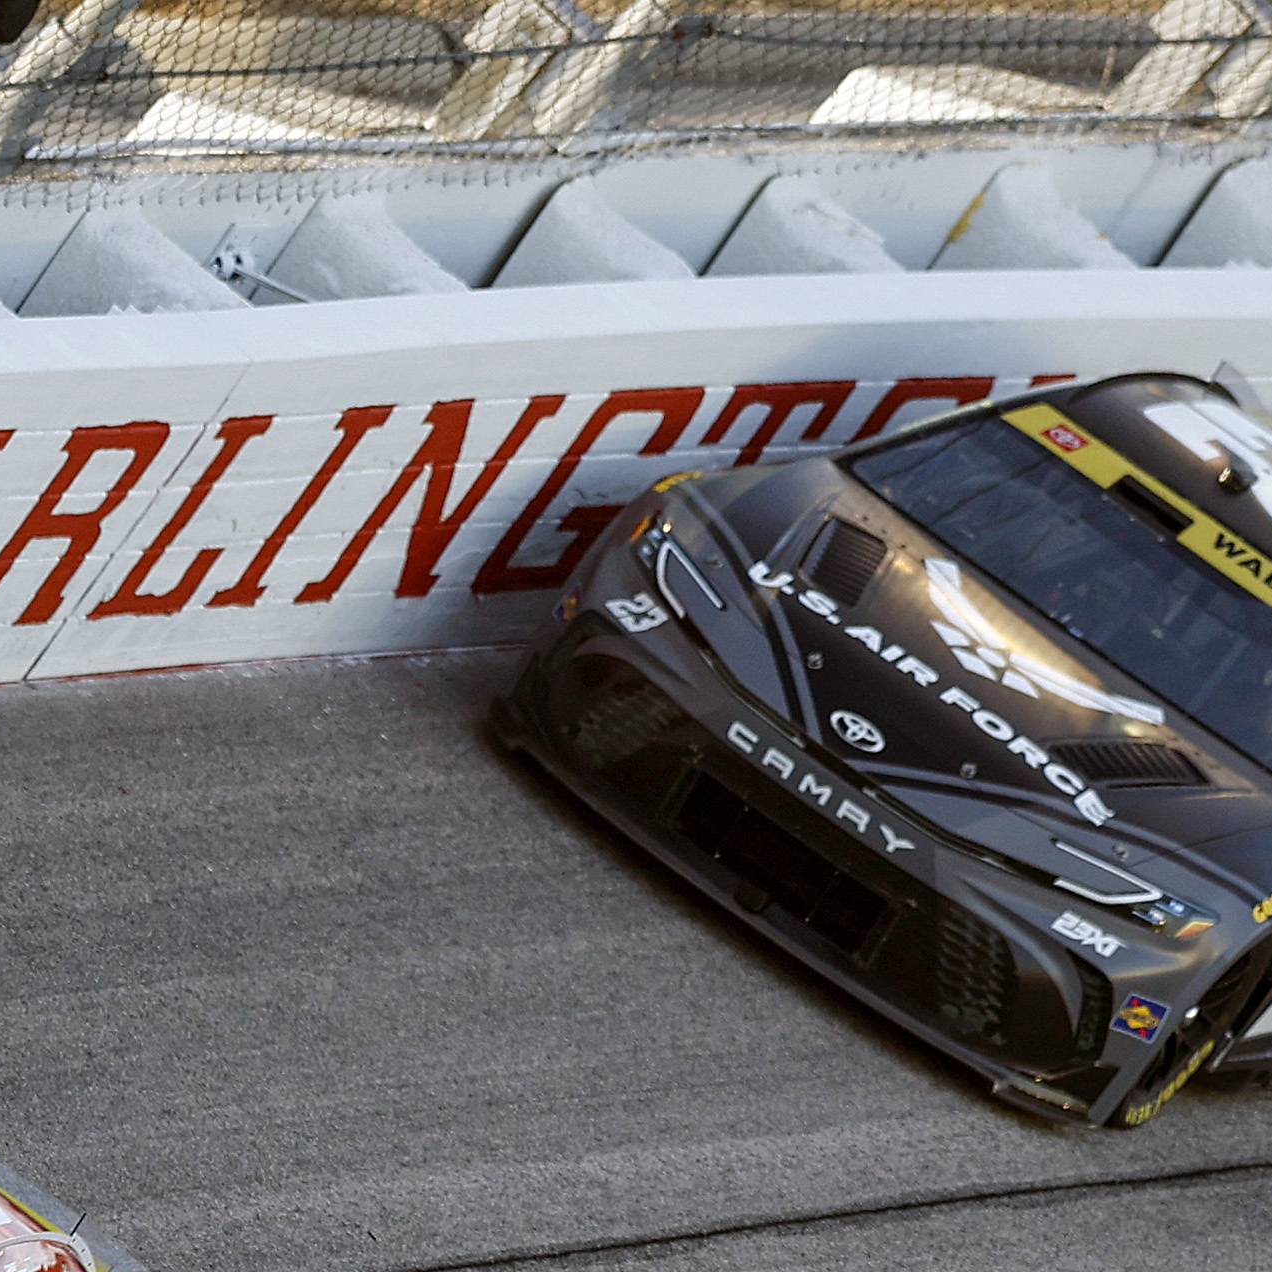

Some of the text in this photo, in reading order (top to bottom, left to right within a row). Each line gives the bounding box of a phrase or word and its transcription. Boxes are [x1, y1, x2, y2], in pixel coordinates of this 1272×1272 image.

[605, 592, 670, 634] 23
[747, 559, 1117, 827] U.S. AIR FORCE
[726, 719, 916, 854] CAMRY
